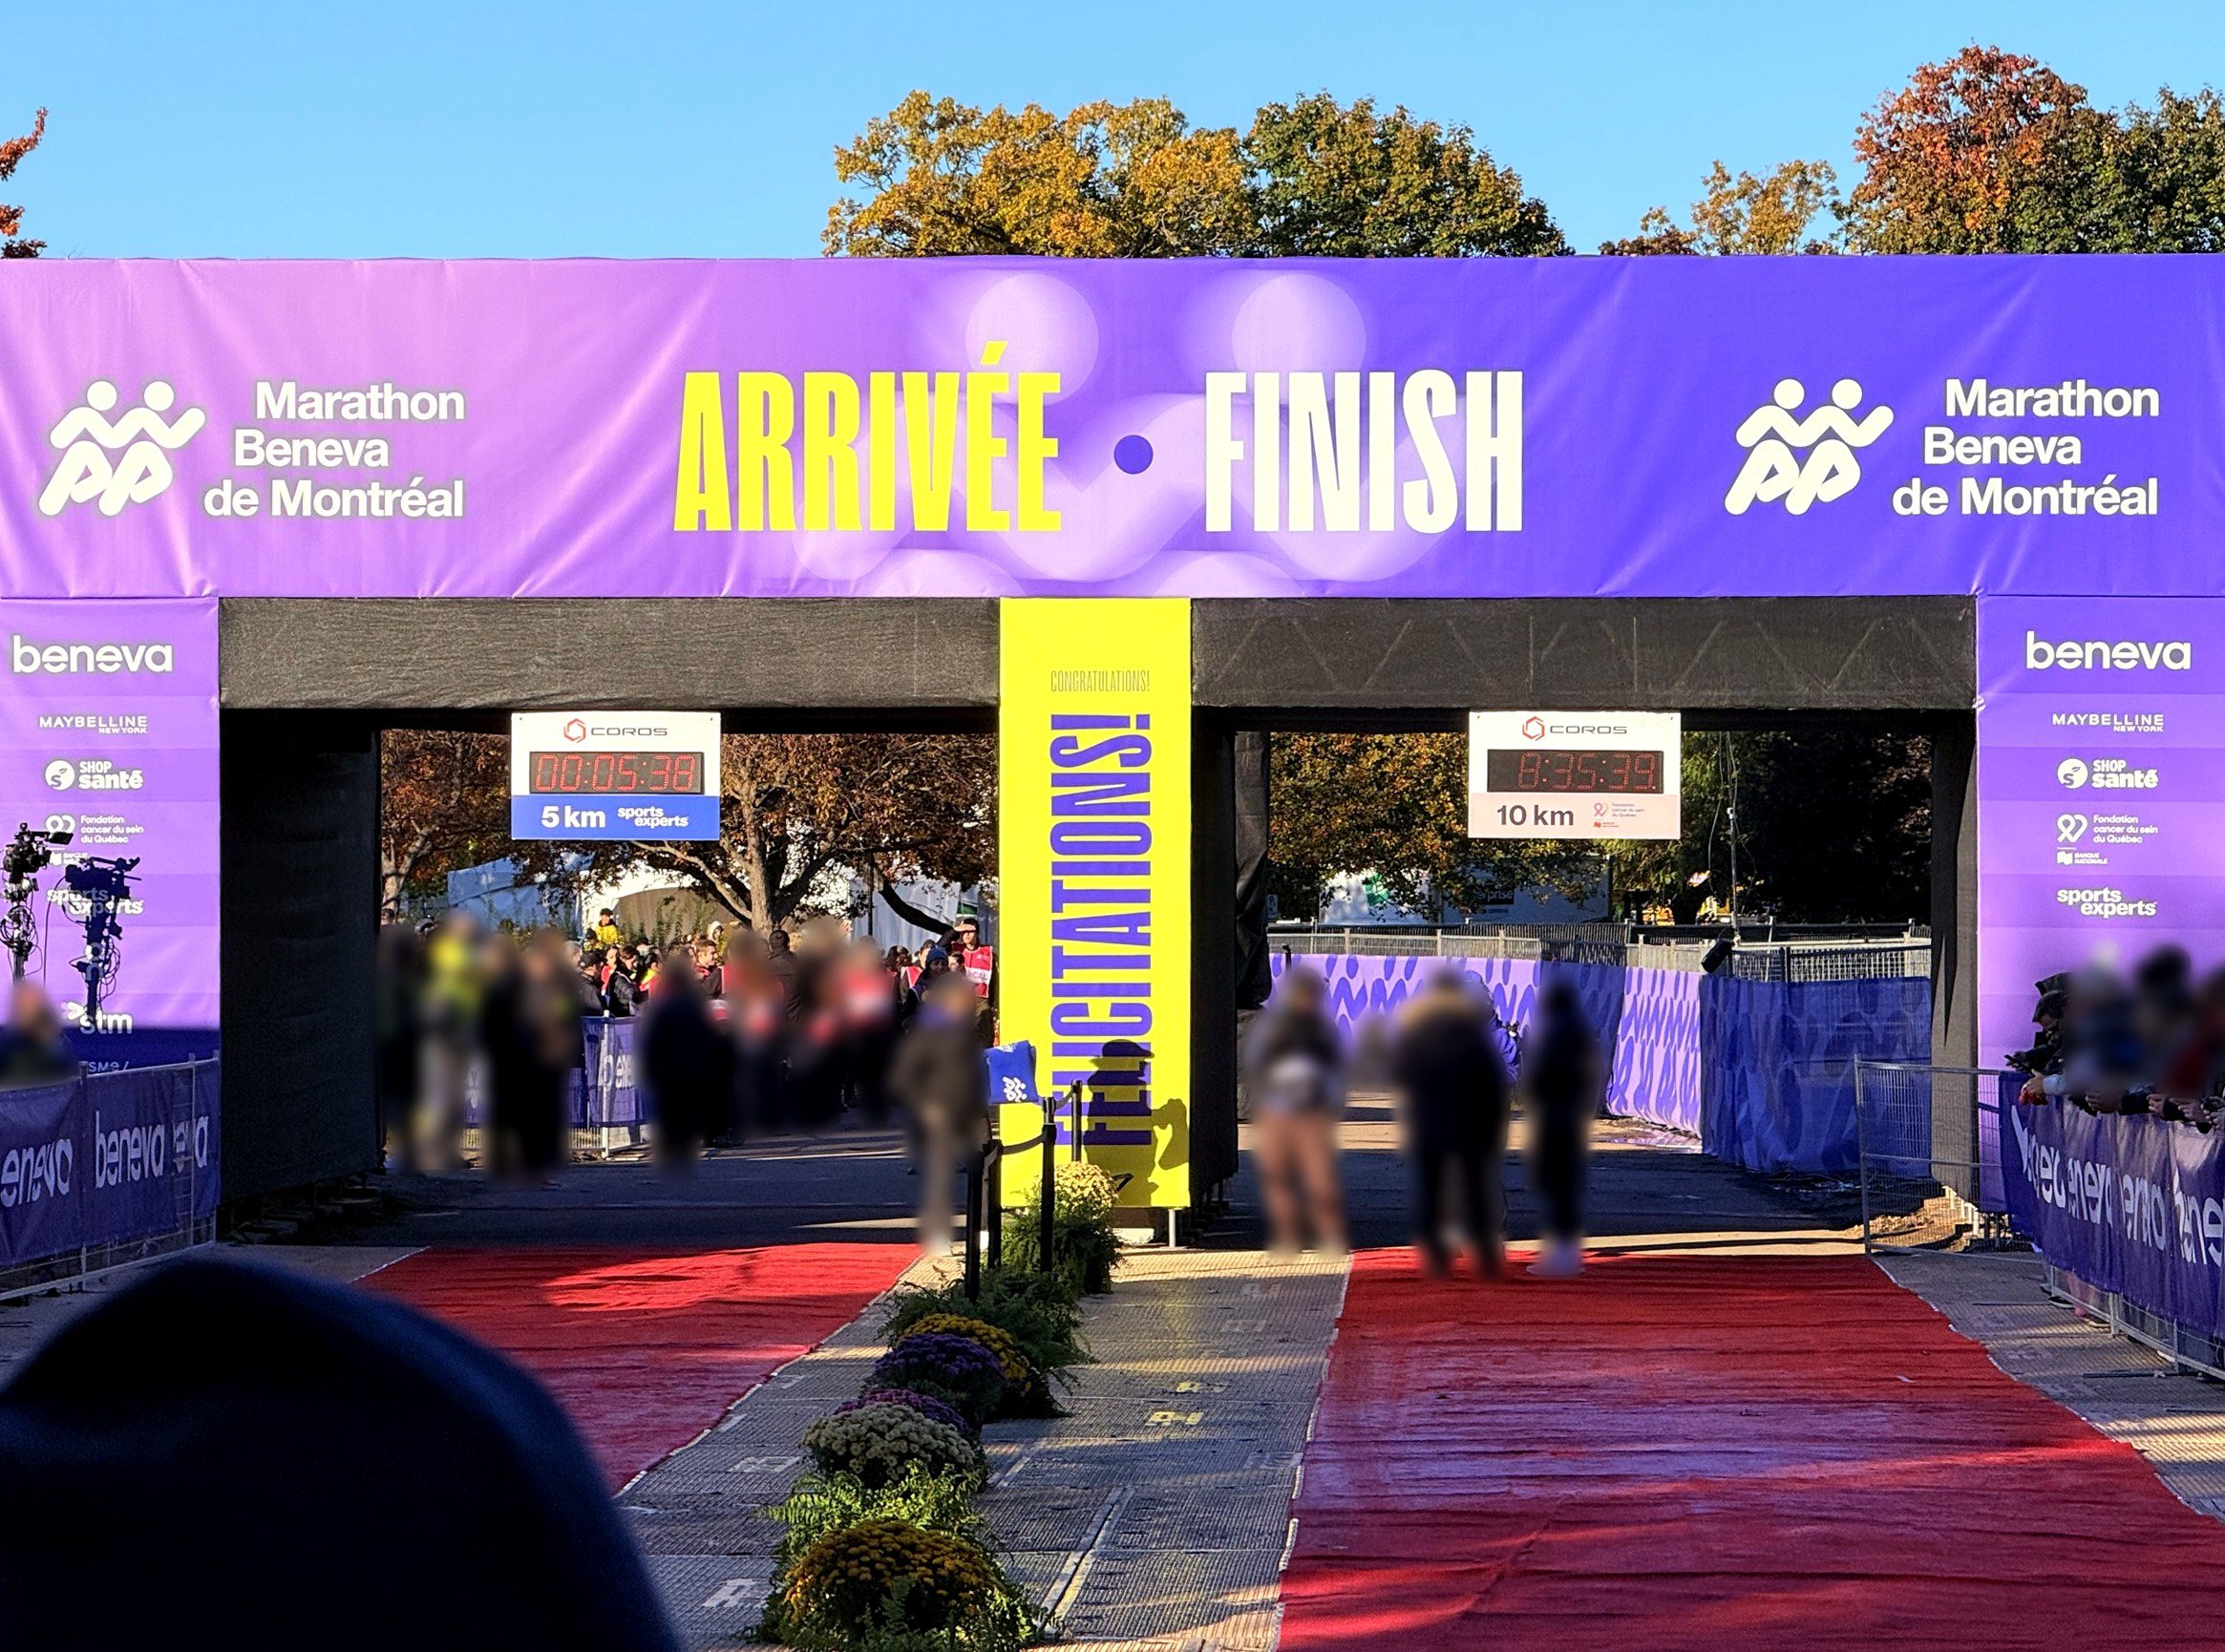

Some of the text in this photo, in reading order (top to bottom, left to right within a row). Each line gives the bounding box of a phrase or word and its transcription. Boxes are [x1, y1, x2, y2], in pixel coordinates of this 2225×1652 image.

[255, 381, 465, 420] Marathon
[1945, 378, 2160, 417] Marathon
[672, 340, 1524, 534] ARRIVÉE FINISH
[1923, 426, 2083, 465] Beneva
[234, 429, 390, 467] Beneva
[203, 477, 464, 518] de Montréal
[1892, 474, 2158, 516] de Montréal
[12, 634, 173, 673] beneva
[2026, 630, 2192, 670] beneva
[1049, 669, 1151, 692] CONGRATULATIONS!
[39, 715, 148, 728] MAYBELLINE
[2052, 713, 2164, 726] MAYBELLINE
[590, 727, 668, 736] COROS
[1549, 725, 1628, 734] COROS
[79, 761, 112, 773] SHOP
[535, 754, 695, 791] 00:05:38
[2093, 759, 2127, 772] SHOP
[78, 771, 144, 789] santé
[2091, 770, 2159, 789] santé
[80, 815, 124, 824] Fondation
[541, 806, 605, 828] 5 km
[617, 806, 664, 821] sports
[634, 815, 689, 829] experts
[1496, 805, 1574, 826] 10 km
[2093, 815, 2139, 824] Fondation
[113, 825, 124, 834] du
[126, 825, 144, 834] sein
[2127, 825, 2138, 834] du
[2140, 824, 2158, 834] sein
[95, 835, 129, 844] Québec
[2093, 834, 2143, 844] du Québec
[2057, 887, 2121, 905] sports
[2080, 900, 2157, 919] experts
[79, 1009, 133, 1034] stm
[95, 1111, 165, 1188] beneva
[1, 1138, 74, 1207] eneva
